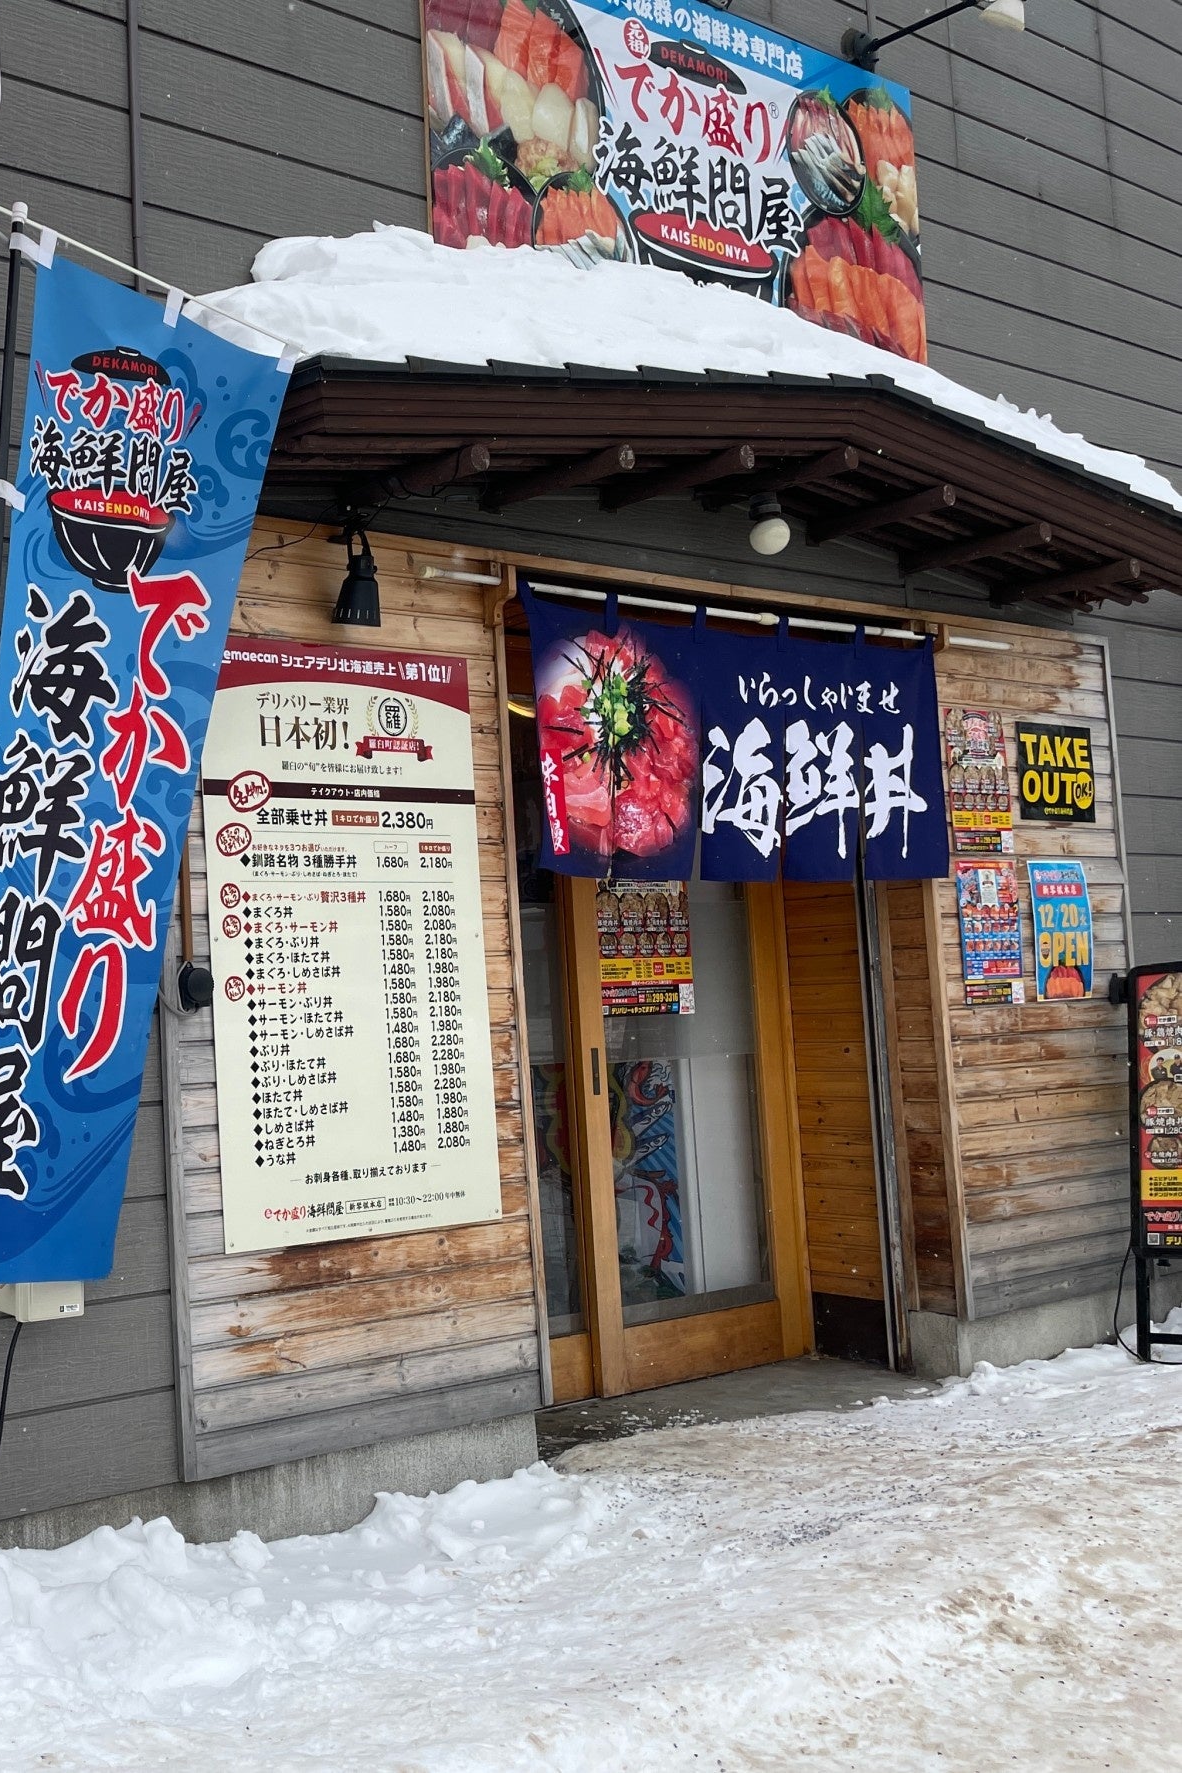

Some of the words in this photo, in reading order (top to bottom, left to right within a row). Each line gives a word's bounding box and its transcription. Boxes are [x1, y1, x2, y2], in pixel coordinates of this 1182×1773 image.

[606, 0, 803, 80] 抜群の海鮮丼専門店
[660, 47, 728, 82] DEKAMORI
[614, 62, 771, 164] でか盛り
[594, 120, 805, 255] 海鮮問屋
[660, 223, 749, 264] KAISENDONYA
[92, 355, 159, 377] DEKAMORI
[46, 370, 185, 445] でか盛り
[31, 416, 198, 514] 海鮮問屋
[74, 498, 151, 521] KAISENDONYA
[281, 654, 396, 677] シェアデリ北海道売上
[256, 692, 350, 716] デリバリー業界
[738, 672, 900, 715] いらっしゃいませ
[259, 713, 350, 750] 日本初!
[1020, 733, 1090, 769] TAKE
[310, 787, 380, 798] テイクアウト・店内価格
[702, 717, 928, 859] 海鮮丼
[1023, 770, 1076, 804] OUT
[1076, 781, 1092, 799] OK!
[541, 751, 566, 852] 味自慢
[58, 568, 212, 1084] でか盛り
[256, 808, 328, 827] 全部乗せ丼
[382, 812, 433, 830] 2,380円
[303, 854, 357, 868] 3種勝手丼
[376, 856, 409, 868] 1,680円
[420, 857, 453, 869] 2,180円
[253, 906, 293, 918] まぐろ丼
[253, 921, 338, 933] まぐろ・サーモン丼
[255, 937, 319, 949] まぐろ・ぶり丼
[1039, 931, 1089, 967] OPEN
[255, 951, 330, 964] まぐろ・ほたて丼
[256, 967, 341, 979] まぐろ・しめさば丼
[257, 982, 307, 995] サーモン丼
[258, 996, 332, 1010] サーモン・ぶり丼
[259, 1011, 343, 1026] サーモン・ほたて丼
[260, 1026, 354, 1041] サーモン・しめさば丼
[260, 1044, 290, 1057] ぶり丼
[260, 1058, 326, 1072] ぶり・ほたて丼
[261, 1072, 337, 1087] ぶり・しめさば丼
[262, 1090, 303, 1104] ほたて丼
[263, 1103, 349, 1119] ほたて・しめさば丼
[265, 1120, 315, 1135] しめさば丼
[265, 1135, 316, 1151] ねぎとろ丼
[266, 1153, 296, 1167] うな丼
[305, 1163, 428, 1185] お刺身各種、取り揃えております
